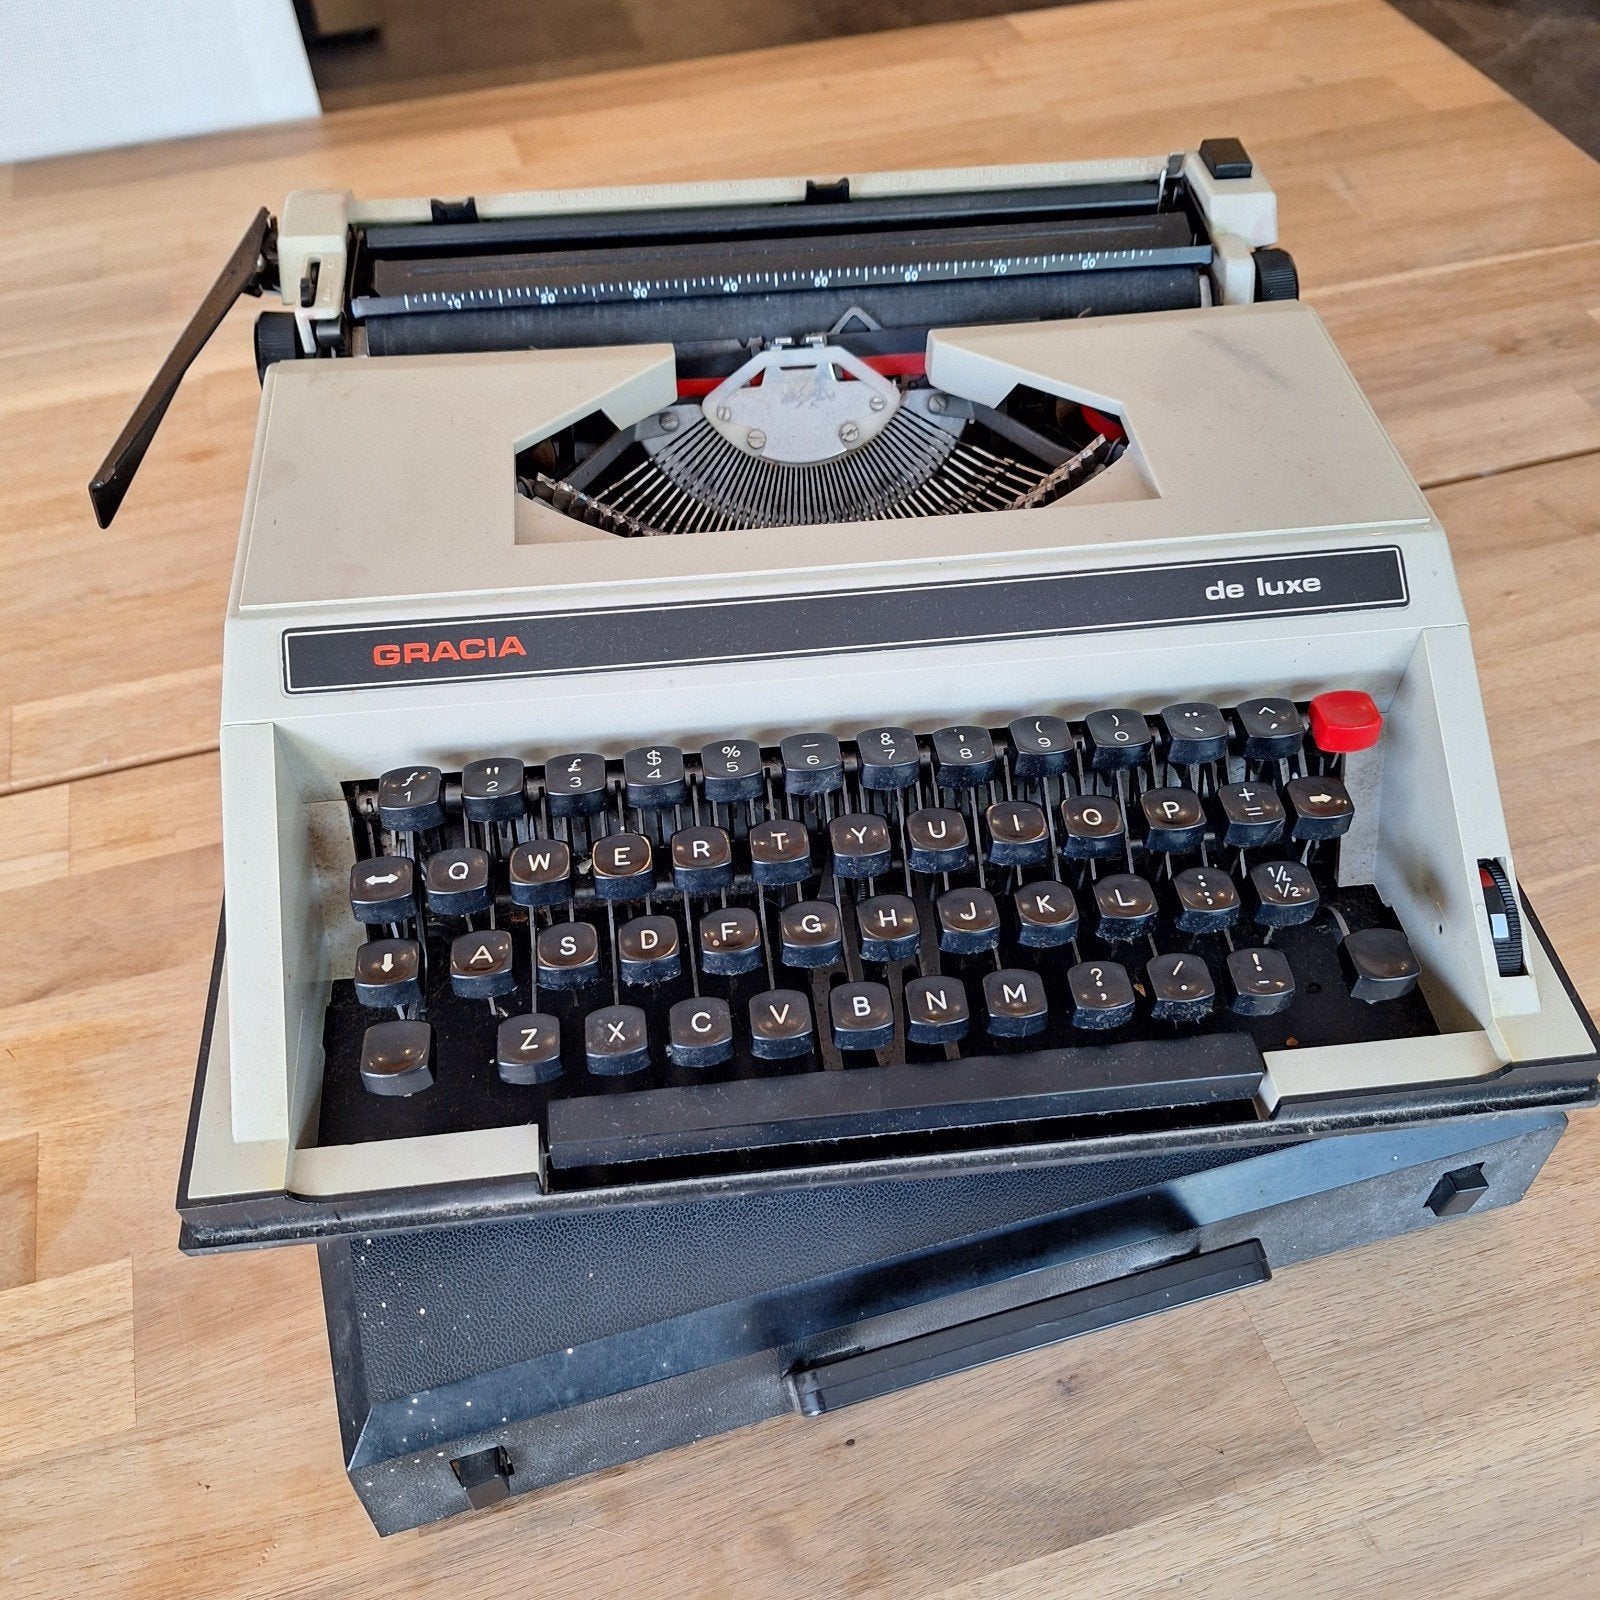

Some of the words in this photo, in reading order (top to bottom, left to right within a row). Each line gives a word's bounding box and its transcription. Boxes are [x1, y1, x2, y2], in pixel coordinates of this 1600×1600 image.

[540, 293, 555, 304] 20
[633, 288, 648, 299] 30
[723, 282, 738, 292] 40
[993, 264, 1007, 275] 70
[1205, 580, 1245, 600] de
[1256, 577, 1321, 597] luxe
[373, 636, 527, 666] GRACIA
[880, 732, 895, 746] &
[1037, 737, 1052, 748] 9
[646, 749, 662, 767] $
[721, 745, 741, 759] %
[806, 755, 820, 765] 6
[882, 748, 896, 760] 7
[959, 748, 973, 759] 8
[567, 758, 582, 773] £
[646, 768, 662, 779] 4
[726, 761, 739, 773] 5
[486, 780, 499, 792] 2
[569, 776, 582, 788] 3
[404, 790, 412, 802] 1
[1238, 787, 1255, 802] +
[1082, 808, 1103, 826] O
[1161, 801, 1181, 819] P
[1244, 806, 1264, 816] =
[851, 826, 868, 844] Y
[927, 820, 947, 839] U
[692, 840, 710, 859] R
[770, 831, 788, 851] T
[527, 852, 551, 872] W
[614, 846, 631, 866] E
[448, 861, 469, 880] Q
[1035, 894, 1056, 914] K
[1114, 888, 1137, 907] L
[878, 908, 898, 928] H
[959, 901, 977, 921] J
[720, 921, 738, 941] F
[800, 914, 822, 933] G
[559, 936, 577, 956] S
[640, 929, 659, 950] D
[469, 945, 494, 965] A
[1252, 953, 1263, 972] !
[1090, 967, 1104, 988] ?
[925, 990, 947, 1013] N
[1002, 983, 1028, 1004] M
[769, 1003, 790, 1025] V
[852, 996, 871, 1017] B
[691, 1011, 712, 1033] C
[520, 1027, 539, 1049] Z
[607, 1021, 626, 1043] X
